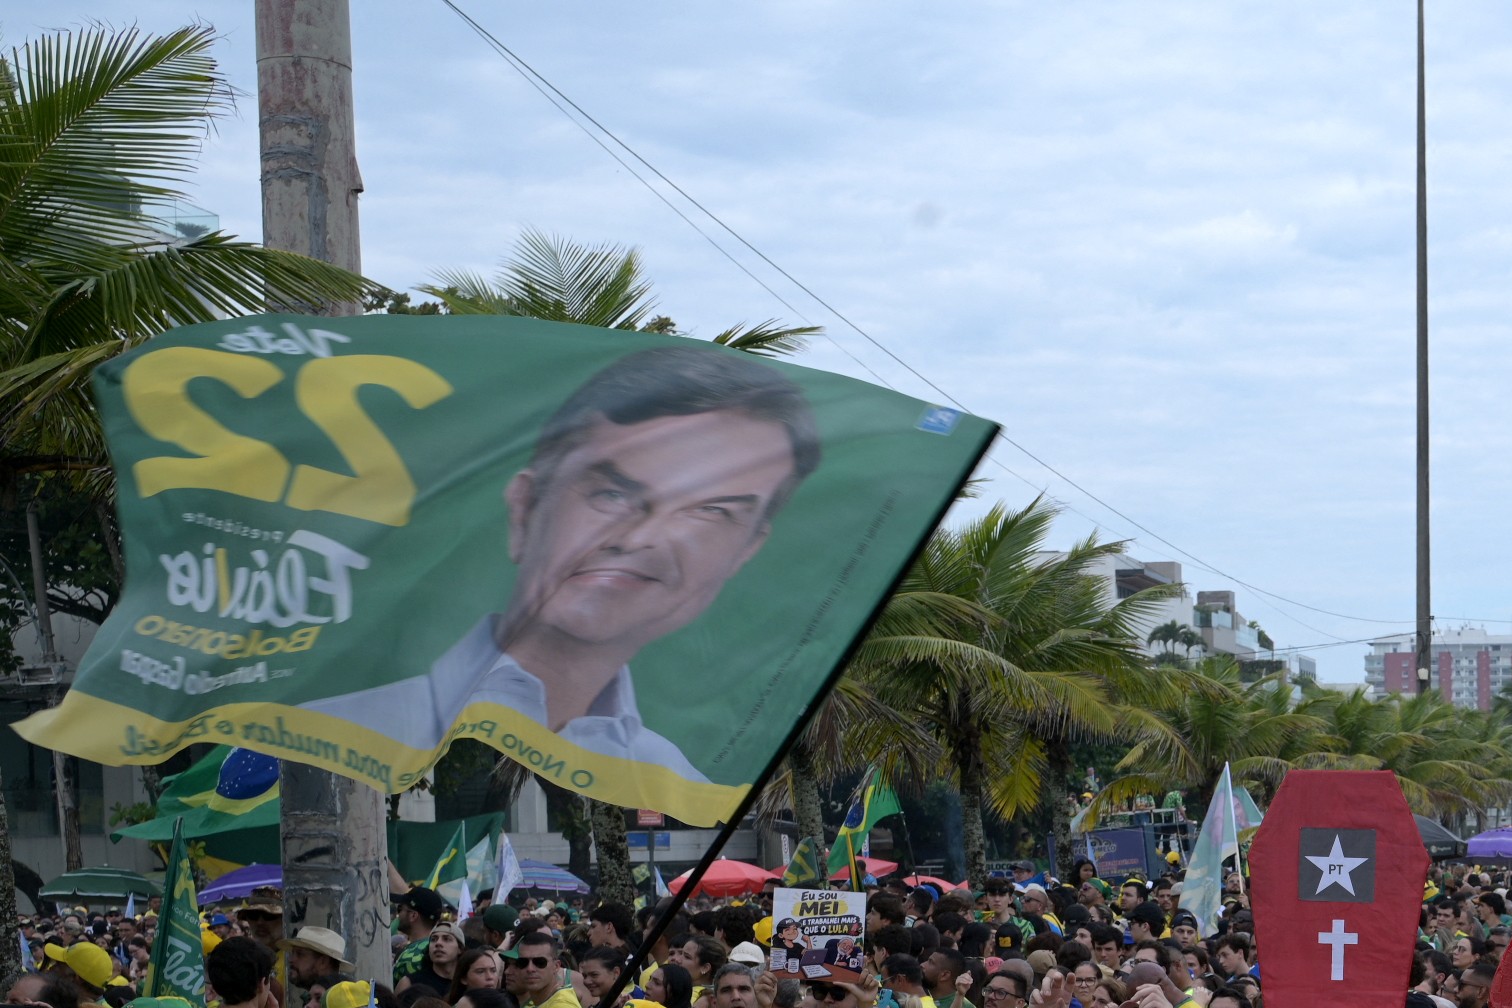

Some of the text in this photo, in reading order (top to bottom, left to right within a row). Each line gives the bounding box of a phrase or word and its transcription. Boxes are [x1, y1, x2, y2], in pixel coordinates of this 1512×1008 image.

[1328, 864, 1344, 875] PT
[799, 902, 839, 917] MEI
[807, 918, 841, 926] TRABALHEI
[841, 916, 857, 924] MAIS
[804, 926, 820, 934] QUE
[828, 924, 849, 934] LULA
